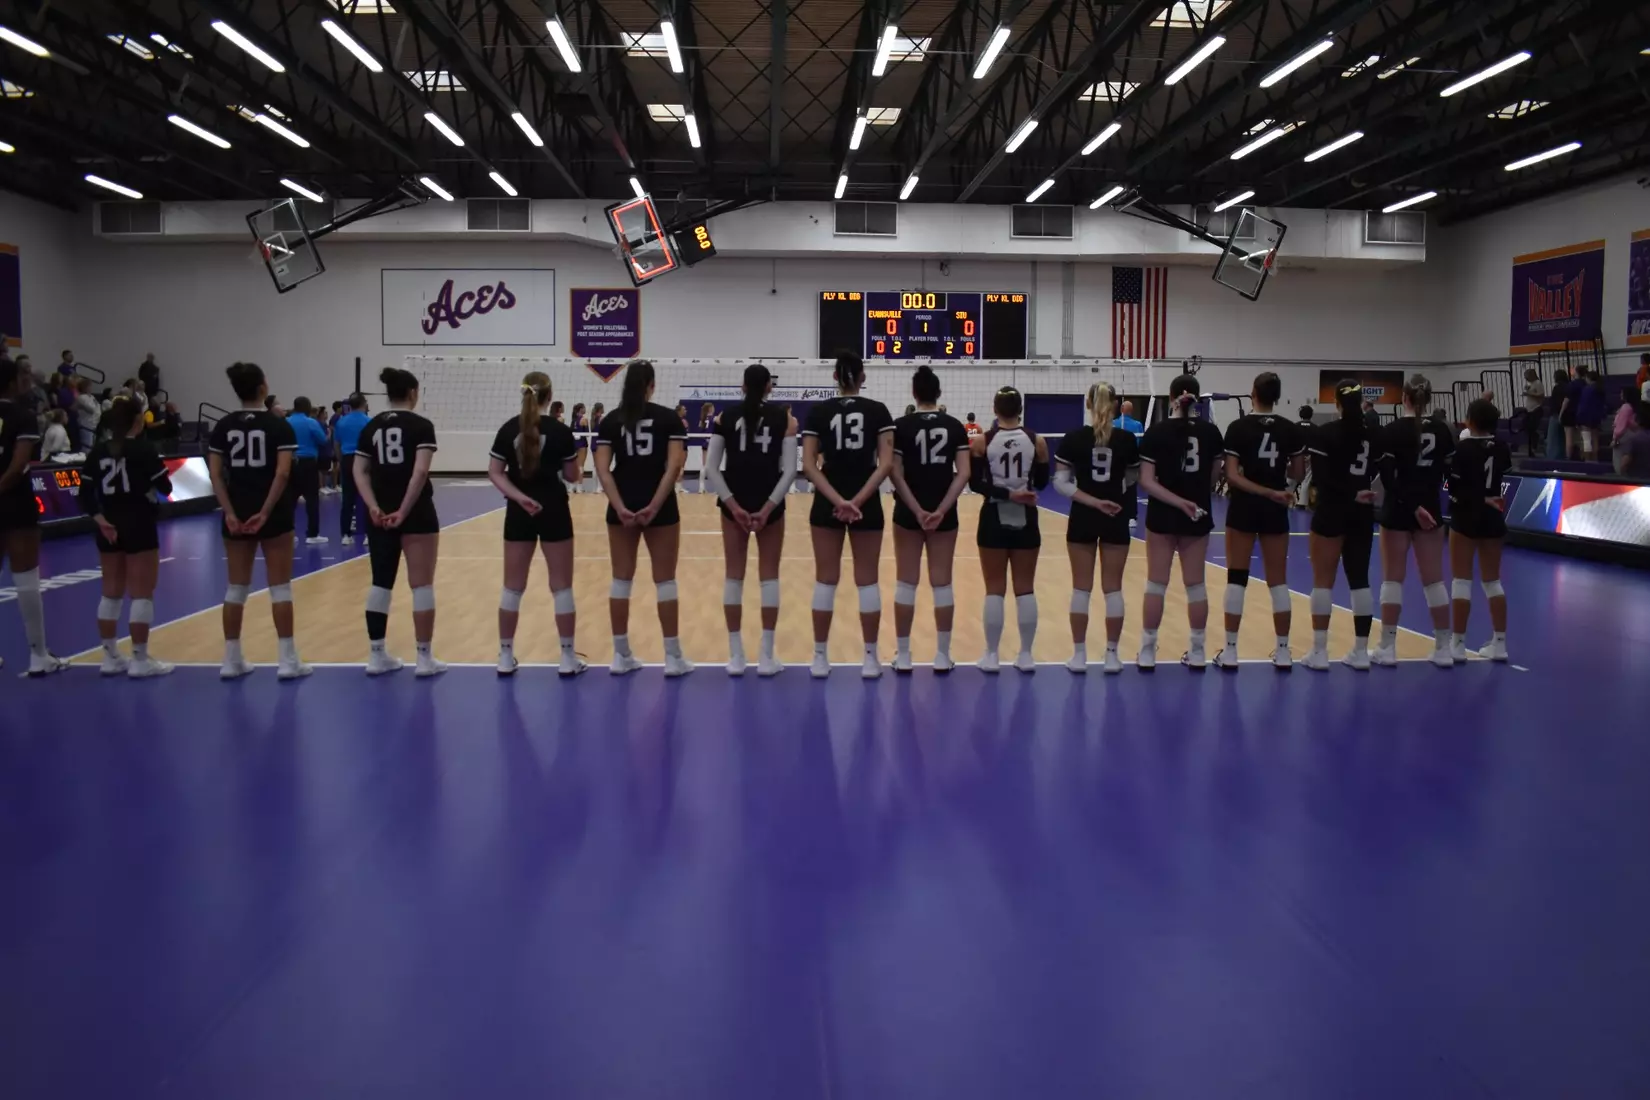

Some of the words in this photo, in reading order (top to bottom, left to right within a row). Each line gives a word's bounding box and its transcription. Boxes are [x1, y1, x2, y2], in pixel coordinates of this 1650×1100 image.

[421, 279, 516, 335] Aces
[582, 293, 628, 321] Aces
[902, 293, 936, 308] 00.0
[1528, 267, 1585, 322] VALLEY
[887, 320, 896, 334] 0
[924, 322, 927, 333] 1
[964, 320, 974, 335] 0
[876, 341, 885, 354] 0
[893, 341, 901, 354] 2
[946, 342, 954, 354] 2
[965, 342, 974, 354] 0
[372, 427, 404, 464] 18
[621, 419, 654, 456] 15
[734, 416, 772, 453] 14
[830, 412, 864, 450] 13
[915, 428, 948, 465] 12
[227, 430, 266, 467] 20
[999, 452, 1023, 478] 11
[1092, 446, 1113, 482] 9
[1258, 433, 1278, 468] 4
[1416, 433, 1435, 467] 2
[55, 470, 81, 487] 00.0
[100, 457, 130, 495] 21
[1484, 456, 1494, 489] 1
